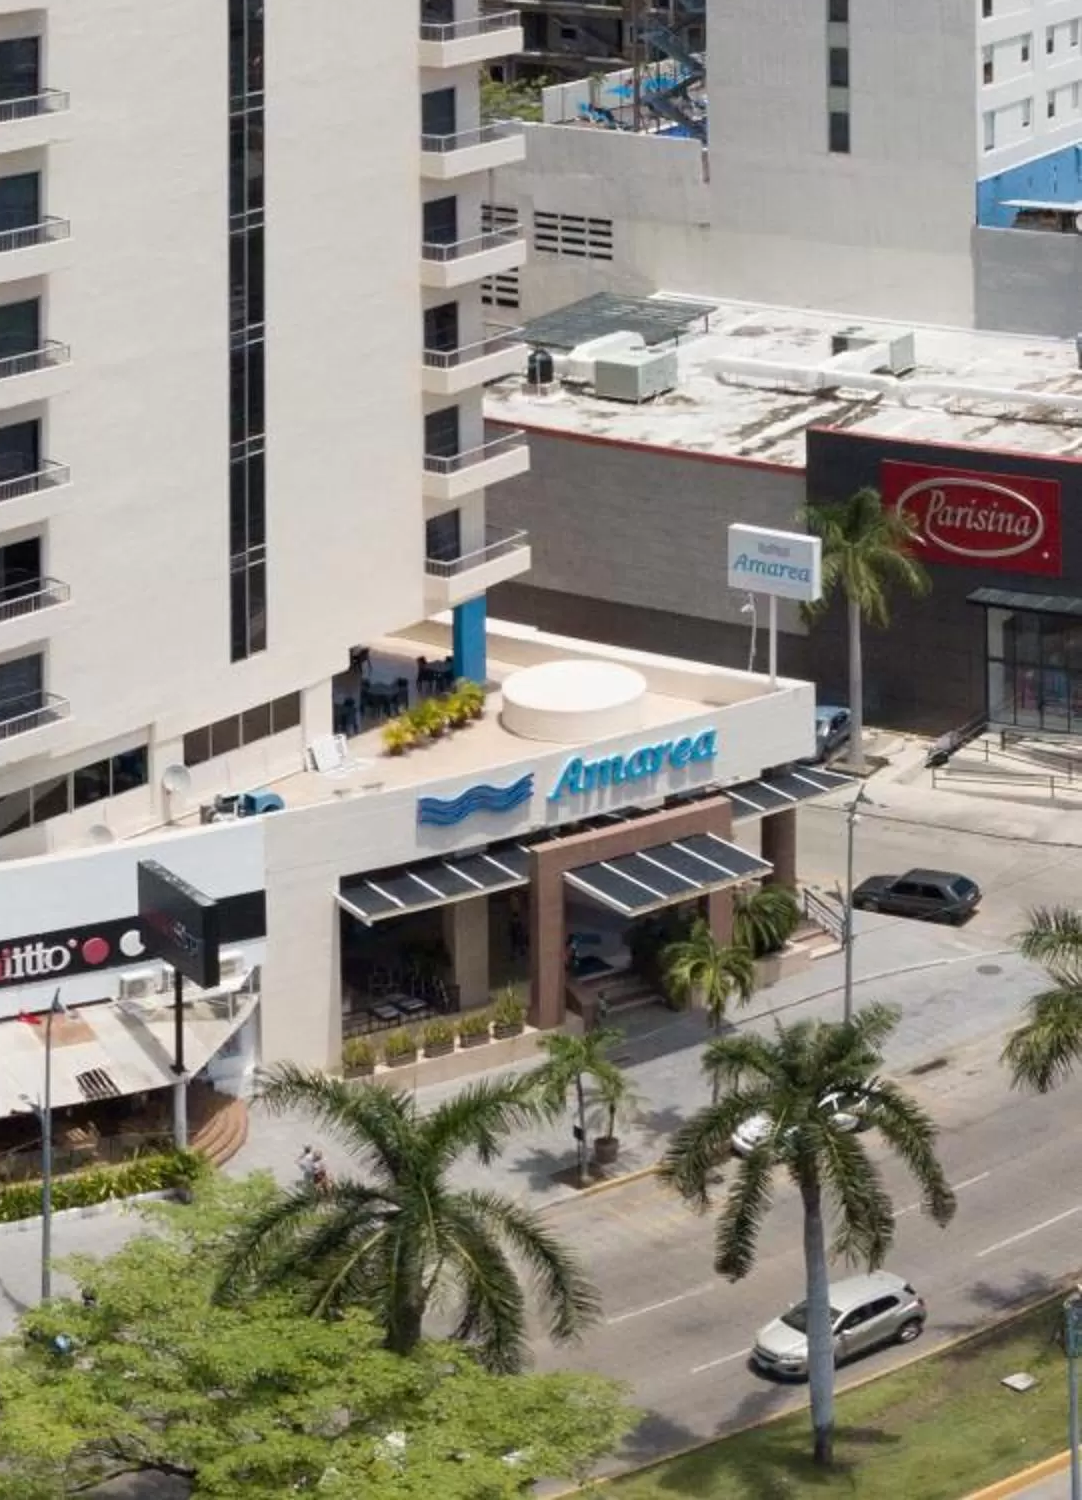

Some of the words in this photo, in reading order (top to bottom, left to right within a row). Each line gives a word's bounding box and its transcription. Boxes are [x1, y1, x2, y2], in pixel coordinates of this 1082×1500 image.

[927, 488, 1032, 537] Parisina
[734, 552, 812, 583] Amarea
[546, 726, 718, 802] Amarea
